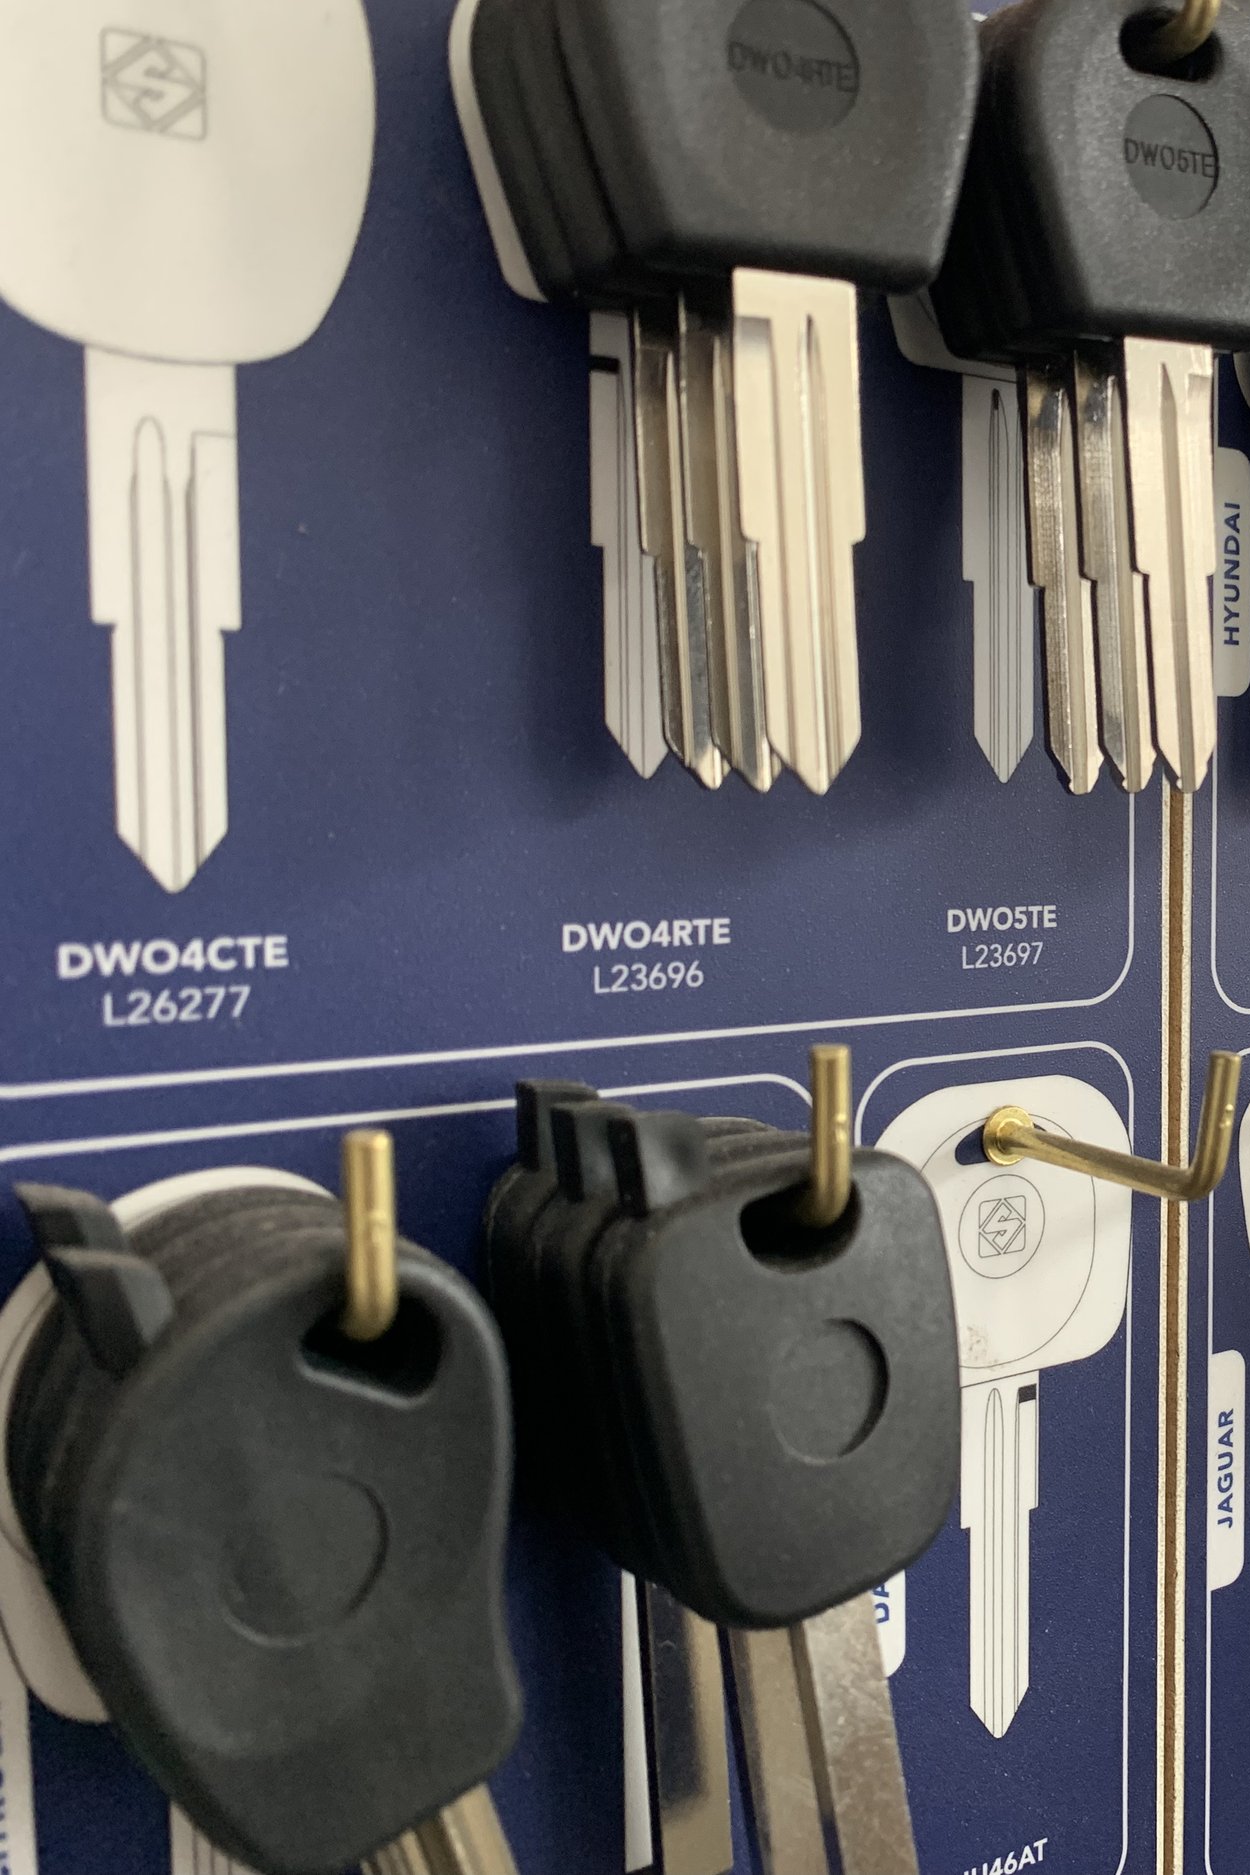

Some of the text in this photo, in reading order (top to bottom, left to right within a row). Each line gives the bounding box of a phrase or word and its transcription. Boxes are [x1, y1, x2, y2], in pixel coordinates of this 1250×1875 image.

[1123, 136, 1218, 179] DWO5TE
[1224, 502, 1241, 646] HYUNDAI
[561, 917, 732, 953] DWO4RTE
[946, 904, 1058, 933] DWO5TE
[56, 934, 290, 980] DWO4CTE
[592, 960, 704, 994] L23696
[961, 941, 1045, 970] L23697
[102, 985, 252, 1028] L26277
[1217, 1407, 1235, 1530] JAGUAR
